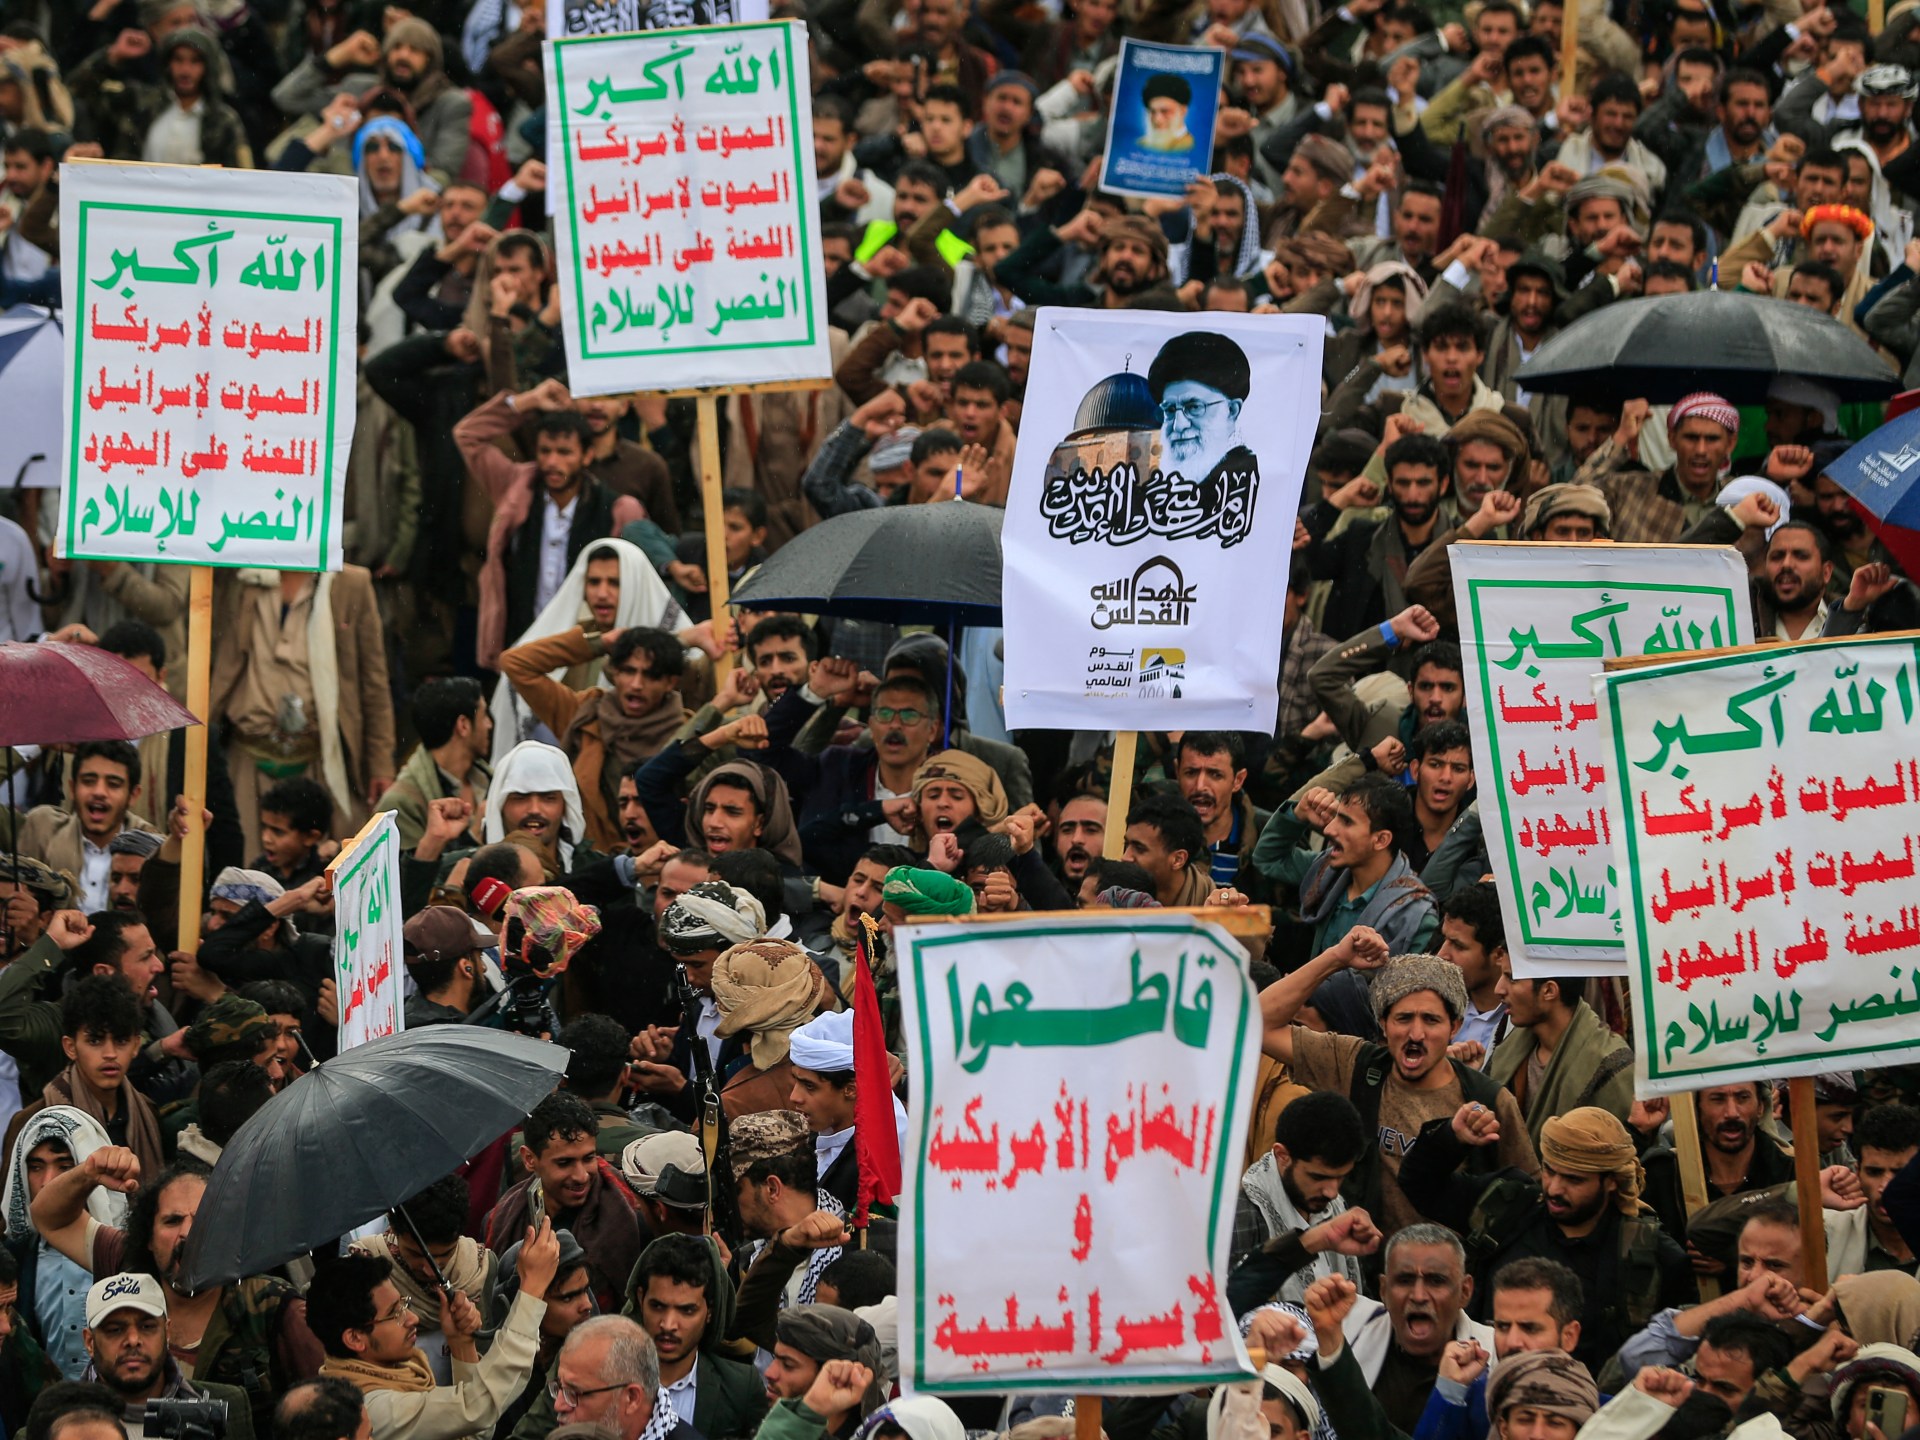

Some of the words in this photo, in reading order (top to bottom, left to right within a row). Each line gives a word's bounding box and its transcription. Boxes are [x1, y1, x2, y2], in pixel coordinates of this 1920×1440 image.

[572, 42, 695, 121] أكبر
[704, 45, 782, 96] الله
[577, 122, 686, 165] لأمريكا
[696, 116, 785, 159] الموت
[582, 177, 691, 224] لإسرائيل
[701, 171, 790, 215] الموت
[90, 220, 236, 300] أكبر
[239, 234, 326, 293] الله
[585, 234, 663, 278] اليهود
[673, 232, 715, 273] على
[727, 225, 794, 260] اللعنة
[91, 302, 212, 353] لأمريكا
[590, 282, 695, 342] للإسلام
[707, 272, 799, 337] النصر
[223, 317, 322, 359] الموت
[88, 367, 210, 418] لإسرائيل
[220, 378, 320, 421] الموت
[84, 431, 170, 474] اليهود
[181, 434, 229, 478] على
[241, 433, 317, 475] اللعنة
[79, 483, 201, 553] للإسلام
[207, 488, 315, 554] النصر
[1089, 646, 1135, 659] يوم
[1491, 592, 1632, 681] أكبر
[1643, 606, 1724, 651] الله
[1085, 676, 1132, 689] العالمي
[1087, 661, 1133, 673] القدس
[1498, 683, 1599, 731] ريكا
[1631, 662, 1797, 781] أكبر
[1809, 663, 1914, 735] الله
[1510, 747, 1606, 796] رائيل
[1798, 758, 1920, 823] الموت
[1641, 764, 1788, 843] لأمريكا
[1519, 808, 1611, 858] اليهود
[1651, 848, 1796, 925] لإسرائيل
[1807, 833, 1920, 897] لموت
[1531, 864, 1622, 935] إسلام
[1773, 919, 1829, 979] على
[1843, 906, 1920, 956] للعنة
[1657, 929, 1760, 992] اليهود
[946, 952, 1215, 1074] قاطعوا
[1664, 990, 1804, 1065] للإسلام
[928, 1078, 1090, 1191] الأمريكية
[1103, 1081, 1216, 1184] البضائع
[1071, 1193, 1093, 1262] و
[101, 1280, 141, 1301] Smile
[933, 1273, 1224, 1372] لإسرائيلية
